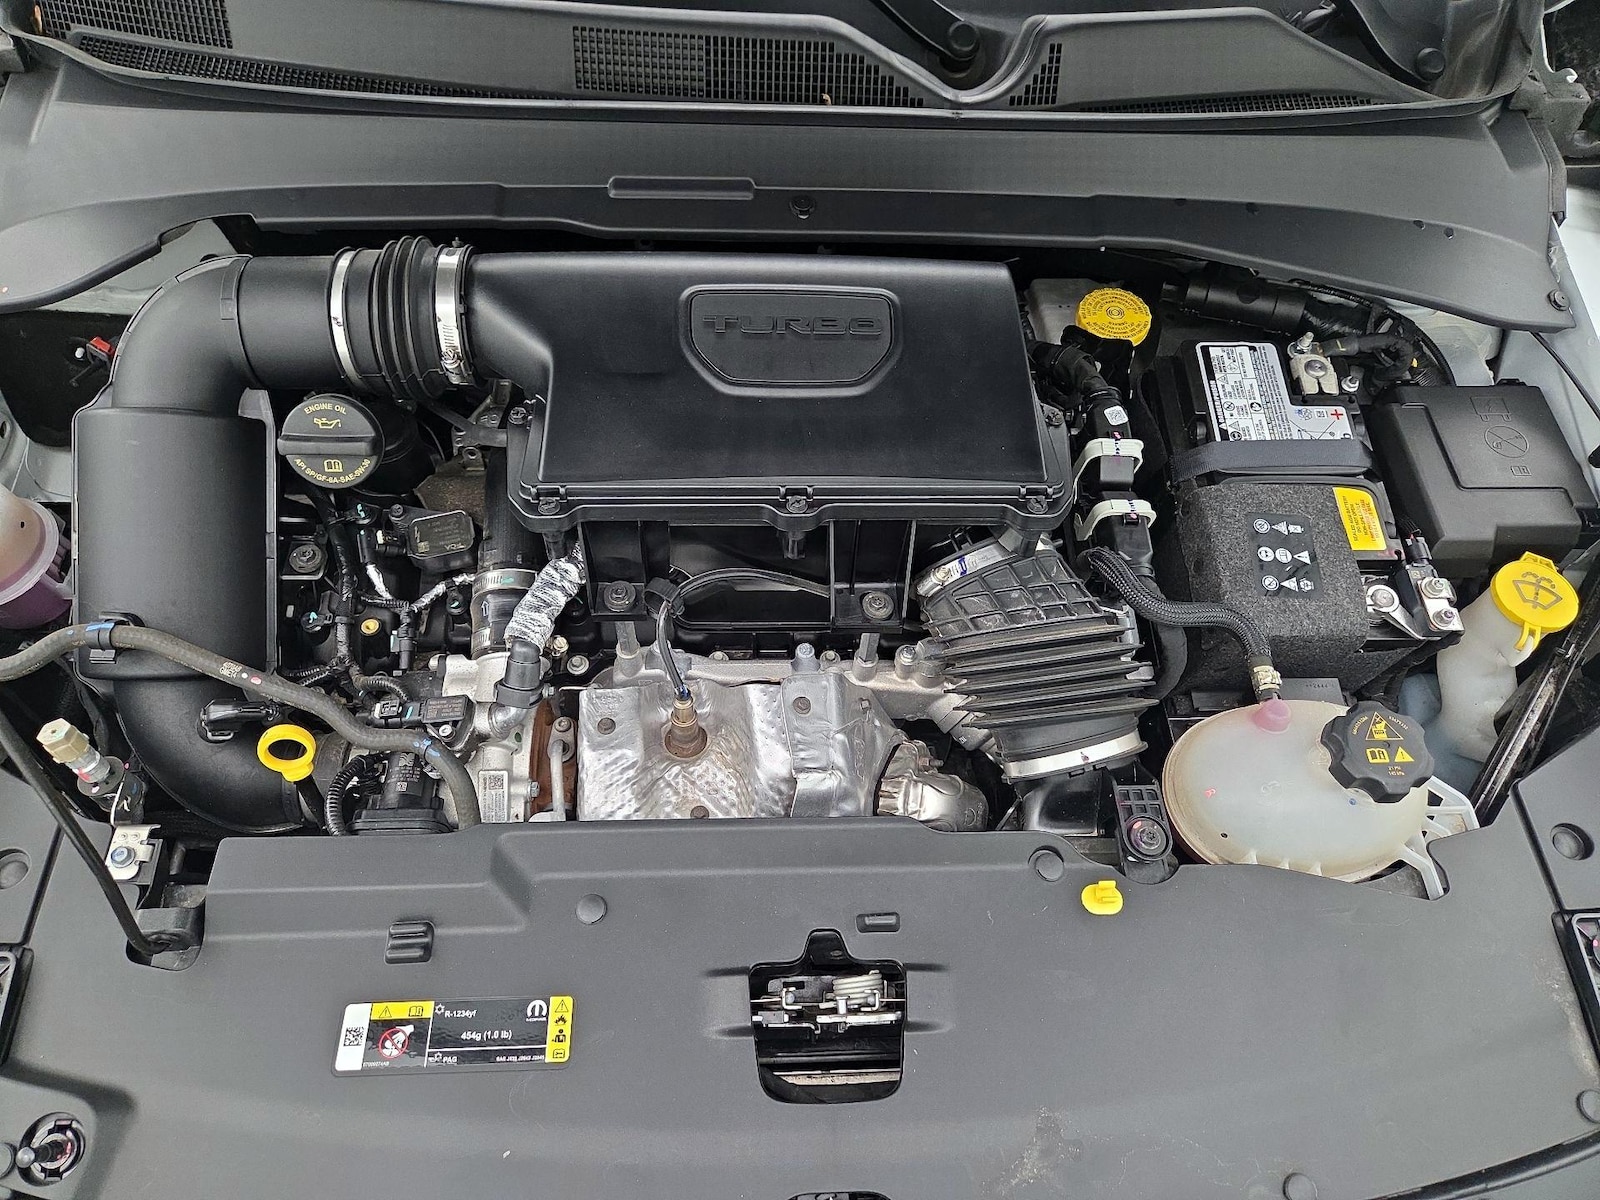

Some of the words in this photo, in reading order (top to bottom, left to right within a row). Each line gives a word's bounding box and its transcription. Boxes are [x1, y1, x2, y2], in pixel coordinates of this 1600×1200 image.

[703, 314, 882, 335] TURBO
[304, 402, 333, 415] ENGINE
[334, 404, 347, 415] OIL
[294, 458, 307, 470] API
[444, 1009, 478, 1018] R-1234yf
[460, 1031, 482, 1041] 454g
[483, 1030, 500, 1041] (1.0
[500, 1029, 513, 1040] lb)
